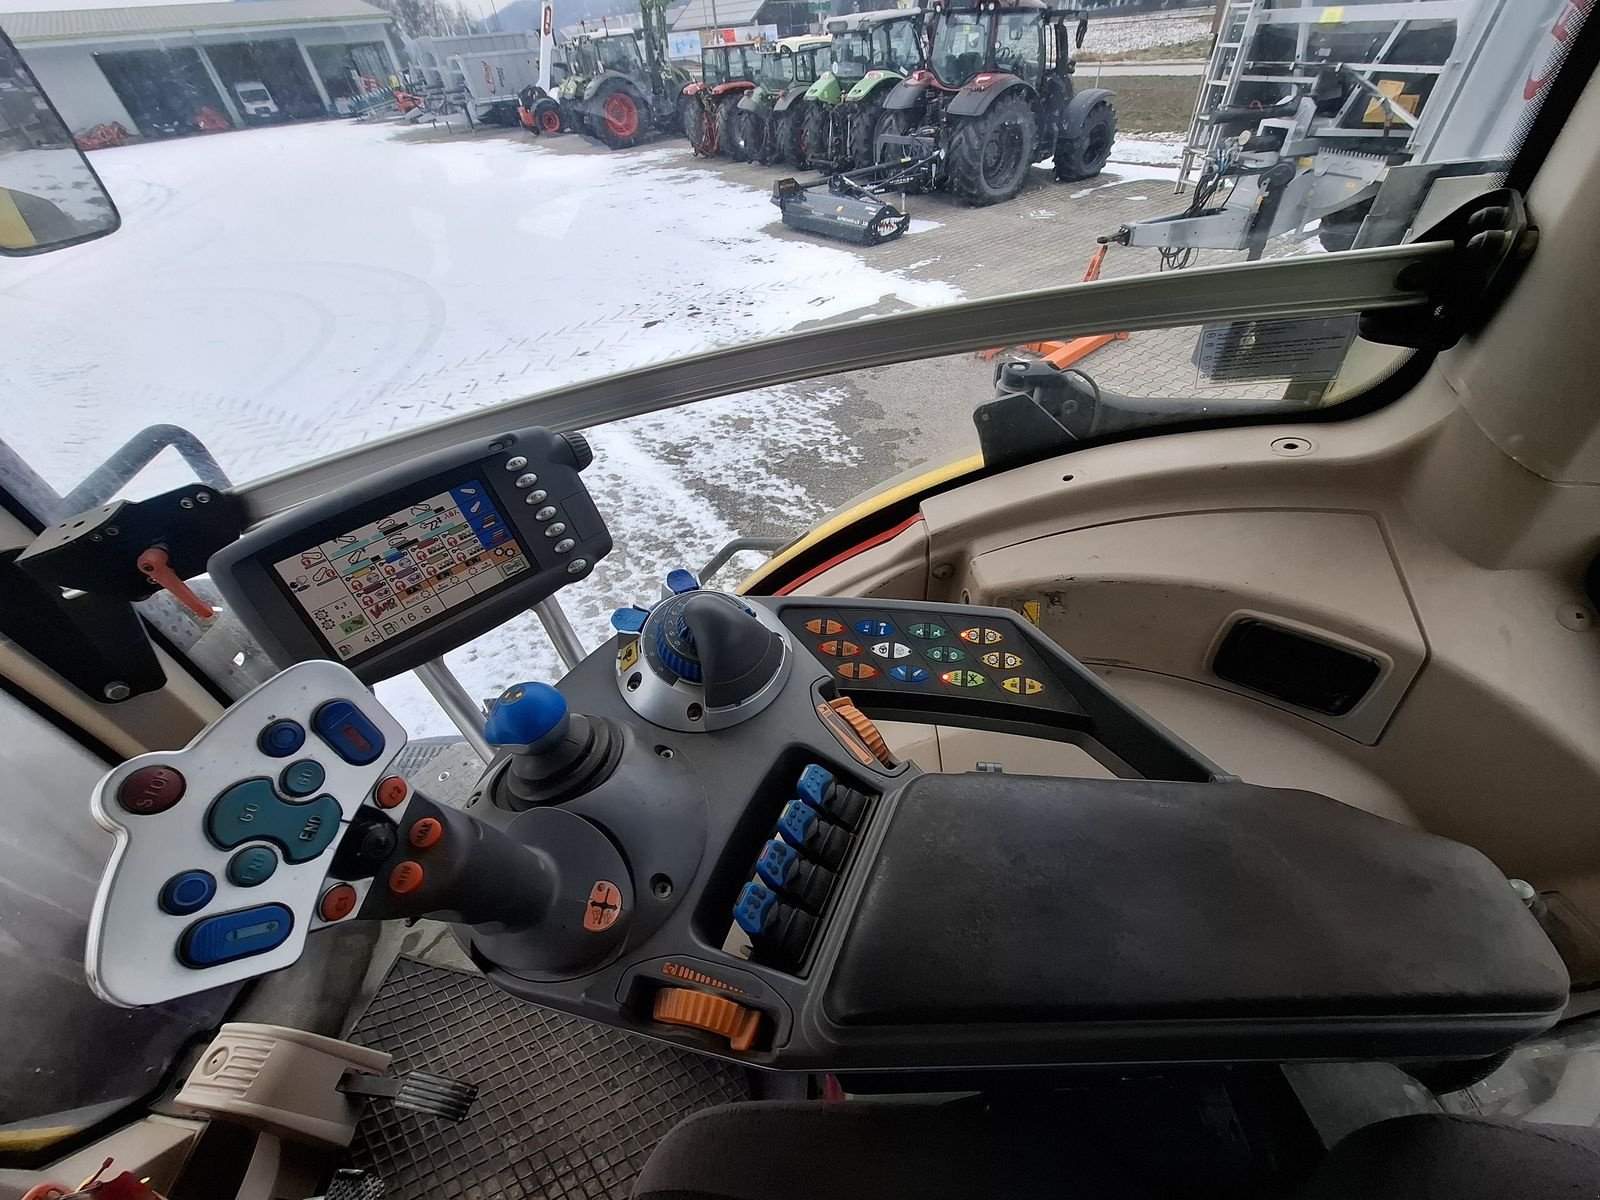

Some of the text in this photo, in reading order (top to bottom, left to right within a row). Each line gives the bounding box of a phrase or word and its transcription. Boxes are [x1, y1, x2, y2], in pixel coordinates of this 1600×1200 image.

[136, 770, 168, 808] STOP
[239, 802, 260, 823] GO
[299, 815, 322, 841] END
